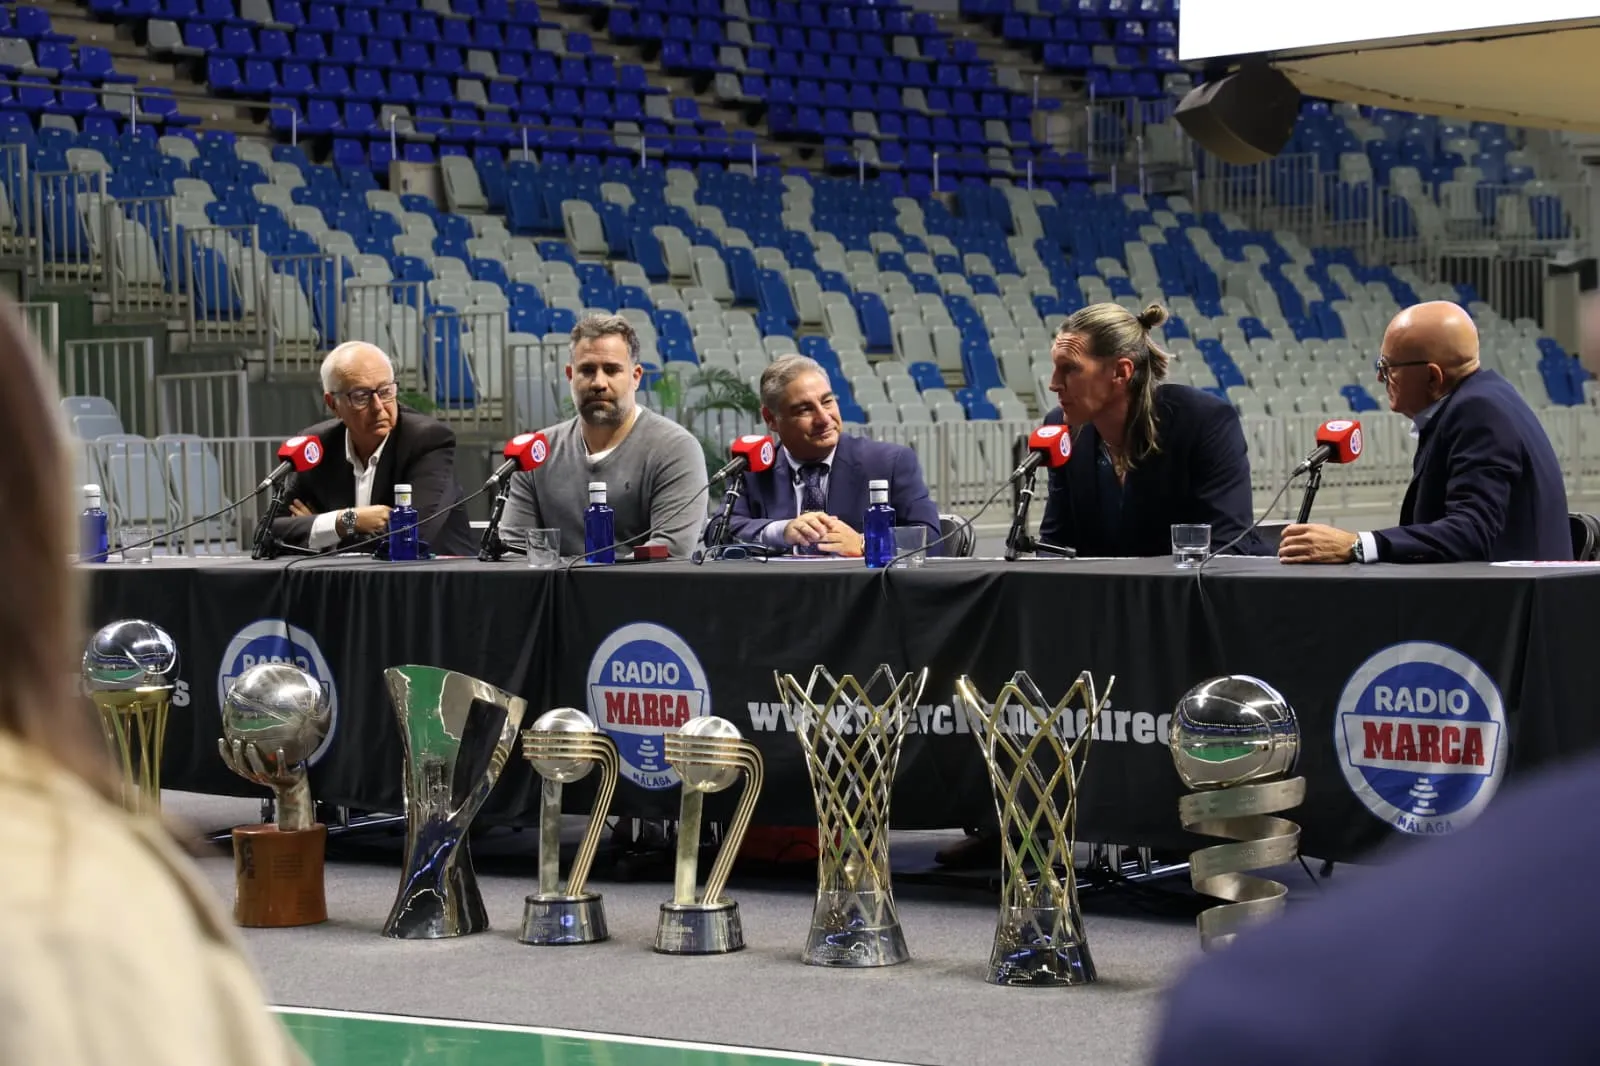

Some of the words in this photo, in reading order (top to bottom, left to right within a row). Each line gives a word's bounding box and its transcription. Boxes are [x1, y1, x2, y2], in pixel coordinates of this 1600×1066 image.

[612, 660, 680, 685] RADIO
[605, 691, 691, 727] MARCA
[1374, 685, 1470, 715] RADIO
[1363, 721, 1485, 766] MARCA
[632, 772, 672, 787] MÁLAGA
